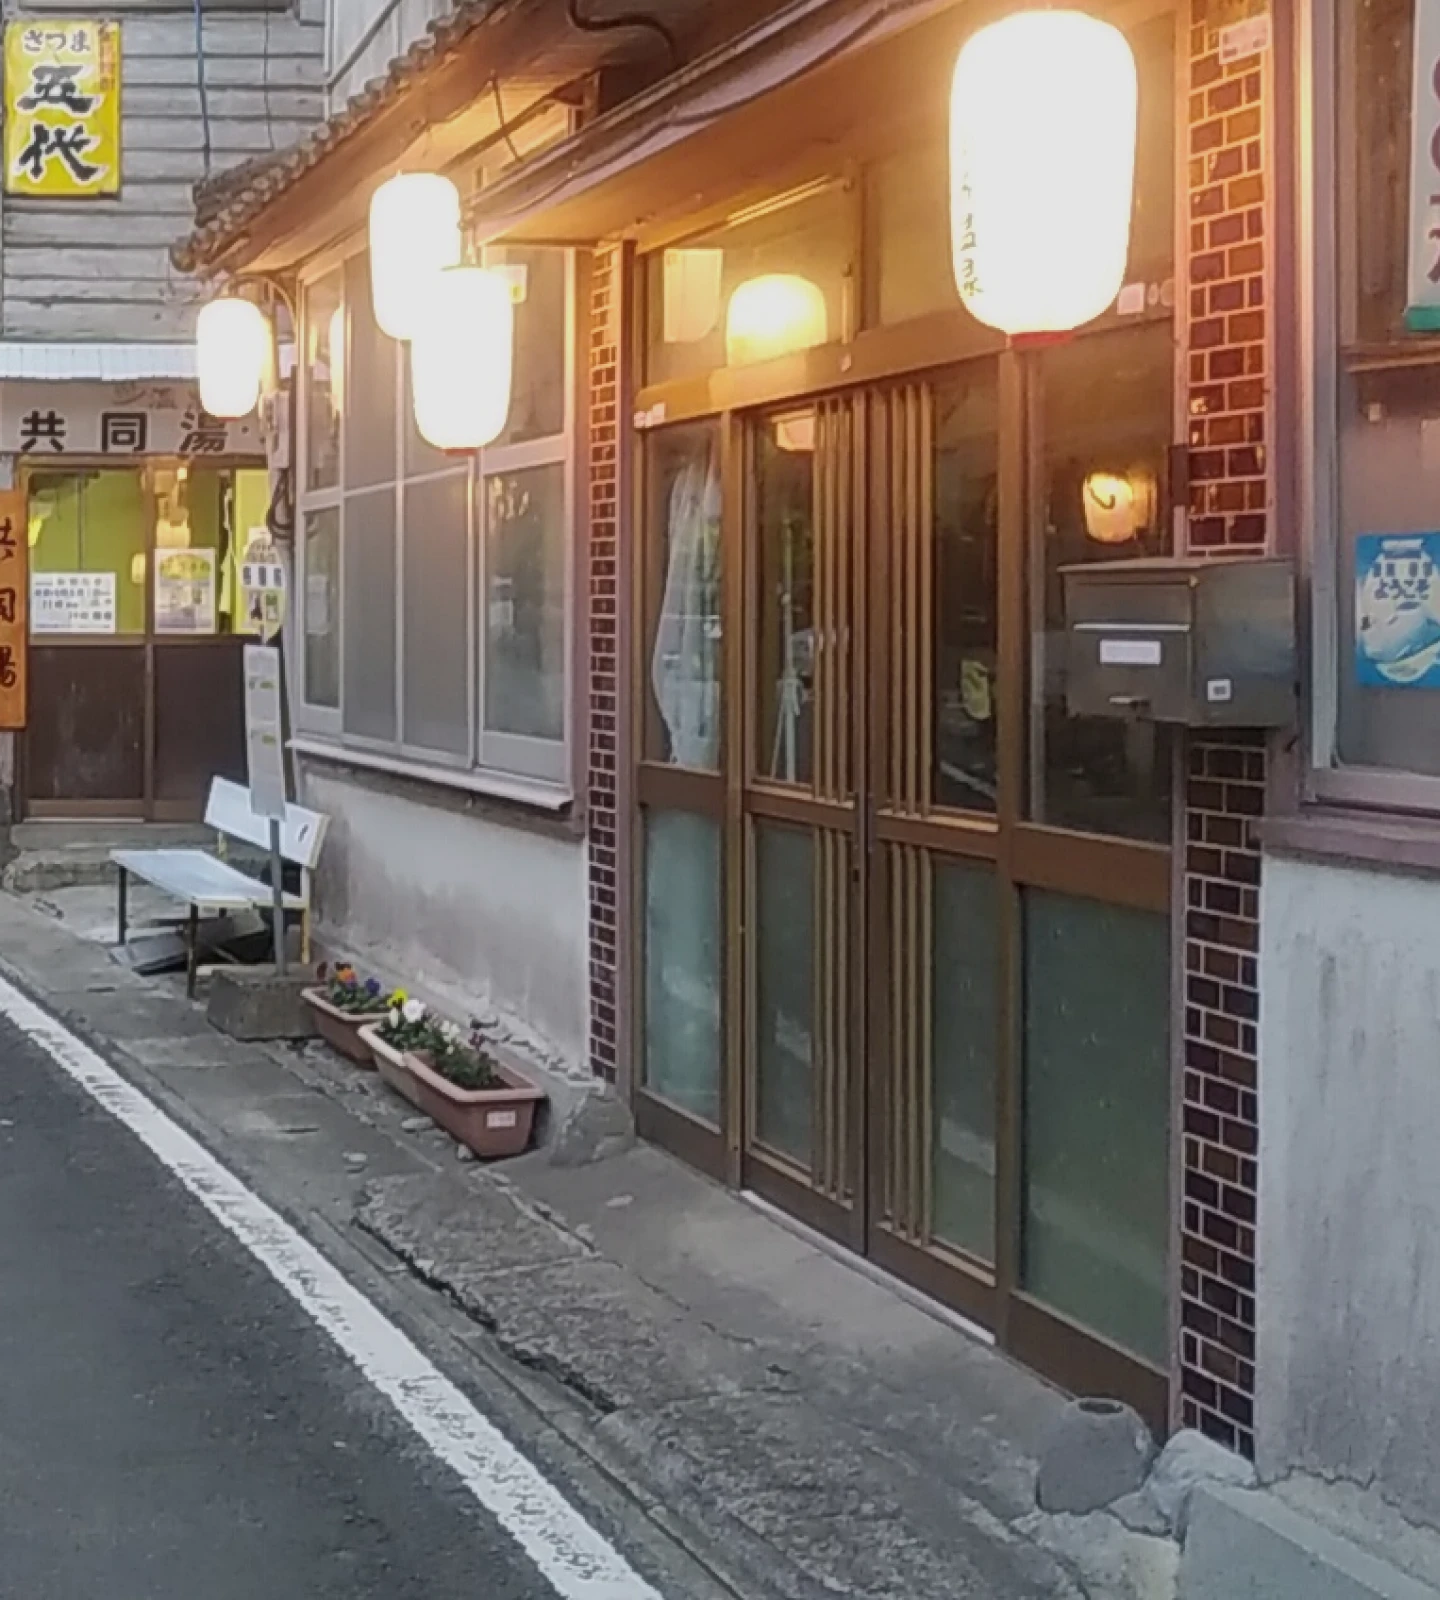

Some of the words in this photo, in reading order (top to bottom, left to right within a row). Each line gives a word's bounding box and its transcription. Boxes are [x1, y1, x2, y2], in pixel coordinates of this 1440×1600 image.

[24, 29, 91, 52] さつま
[15, 64, 105, 181] 五代
[20, 410, 228, 452] 共同湯
